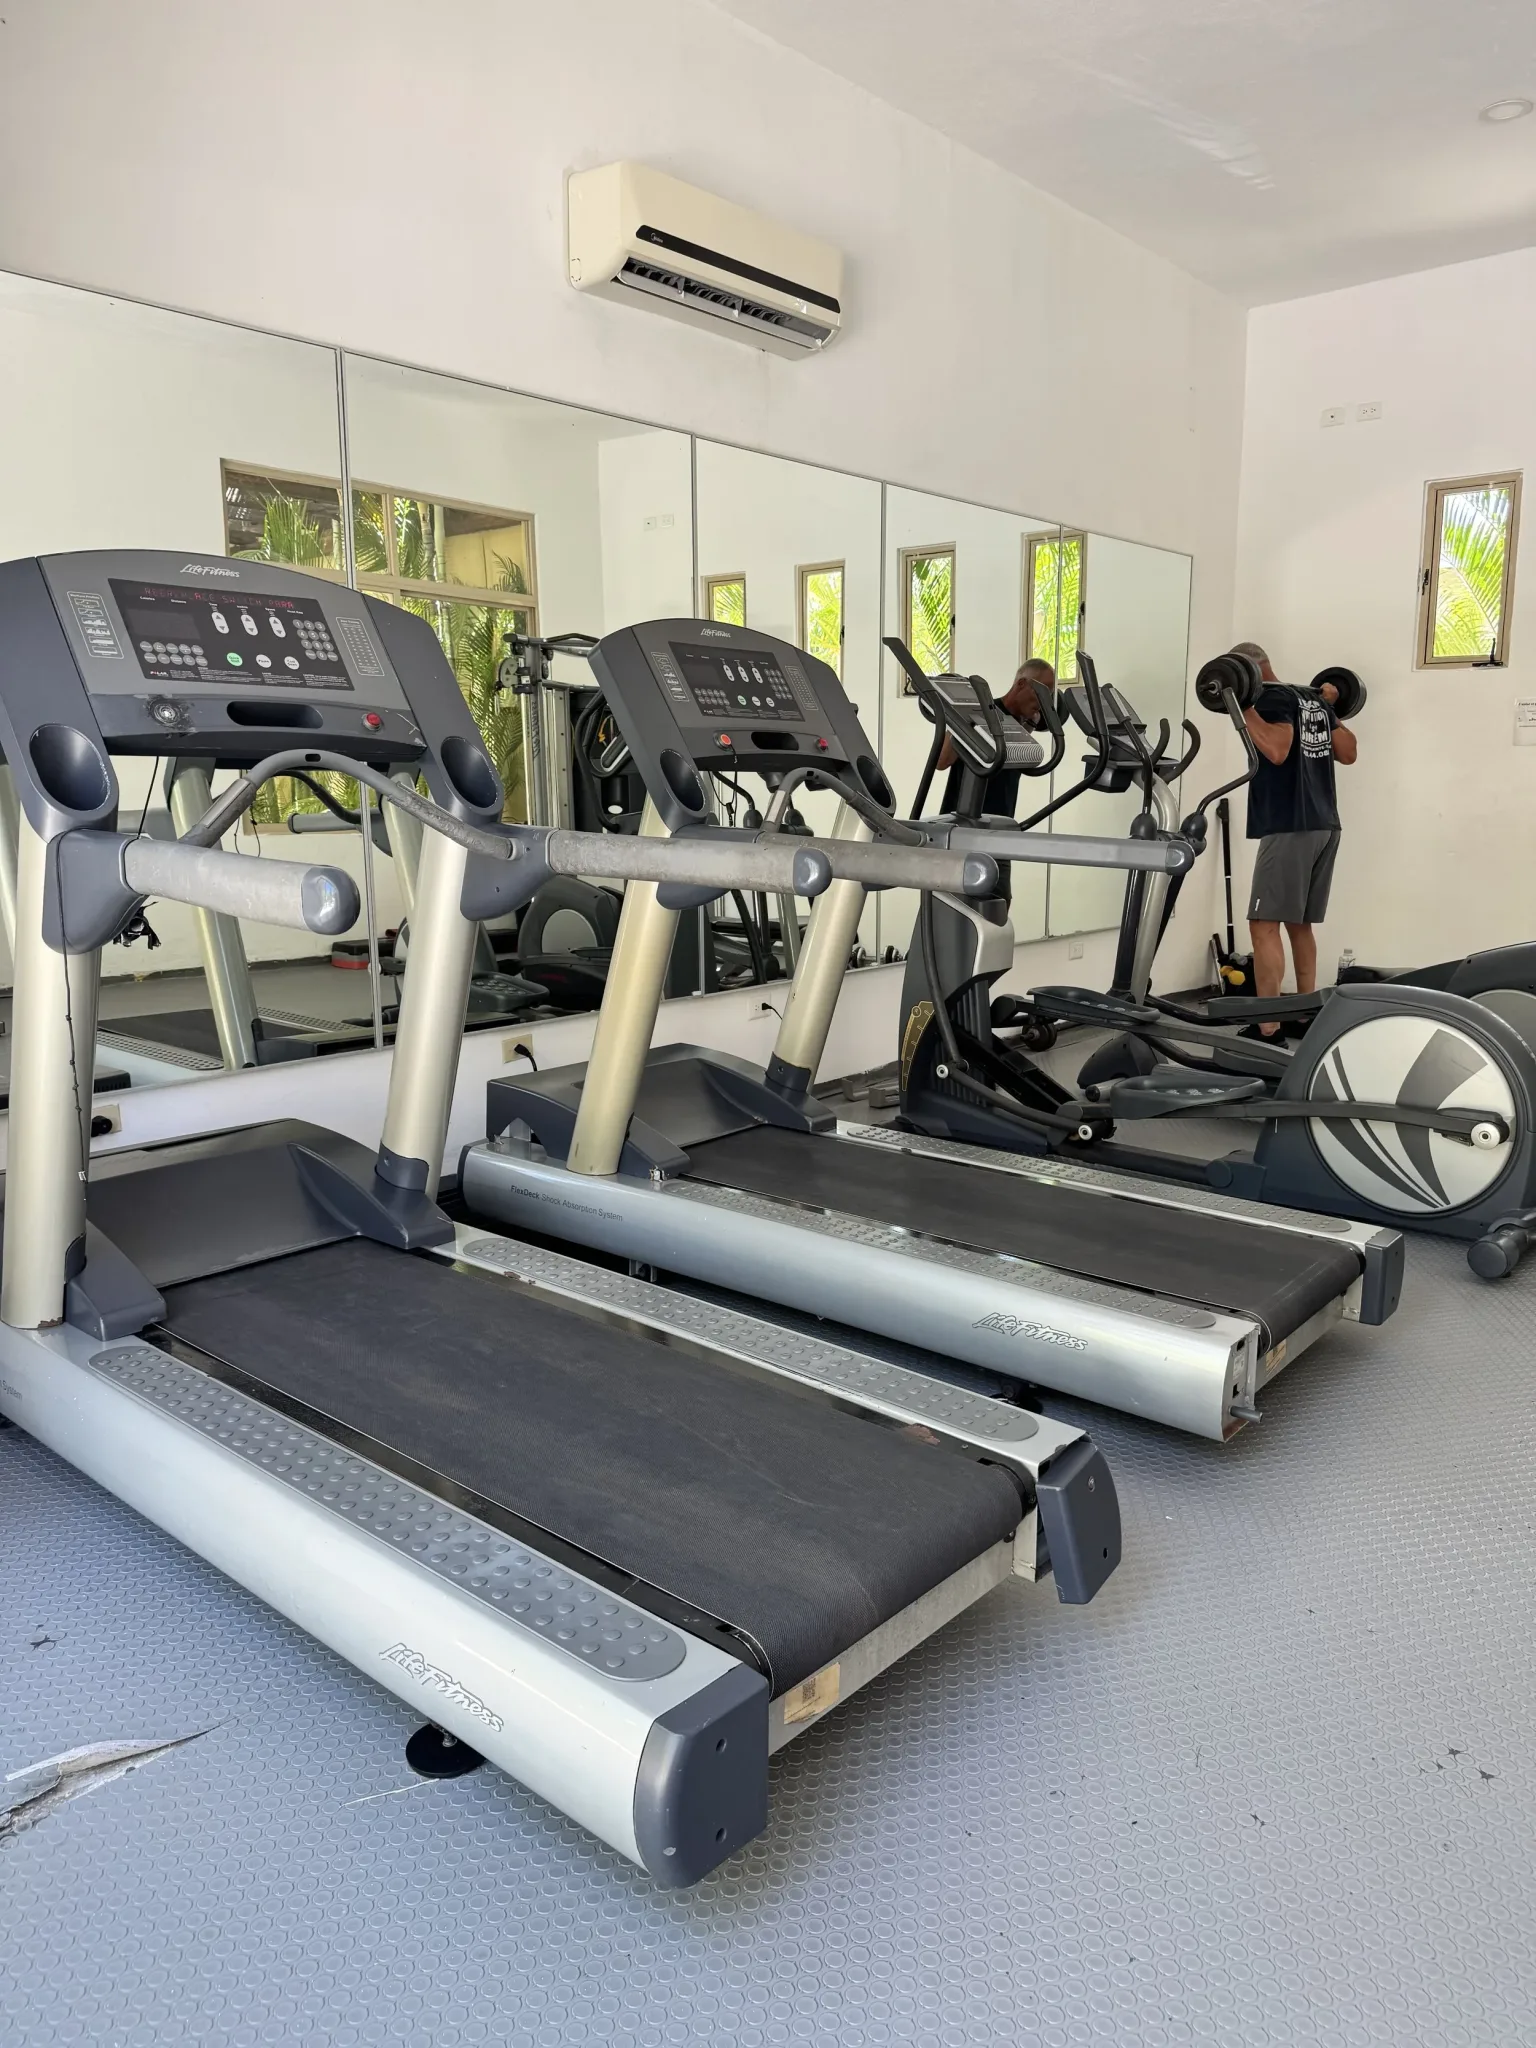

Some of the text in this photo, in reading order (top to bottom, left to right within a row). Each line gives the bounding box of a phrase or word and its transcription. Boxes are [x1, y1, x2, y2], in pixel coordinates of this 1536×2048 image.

[510, 1184, 623, 1222] FlexDeck Shock Absorption System
